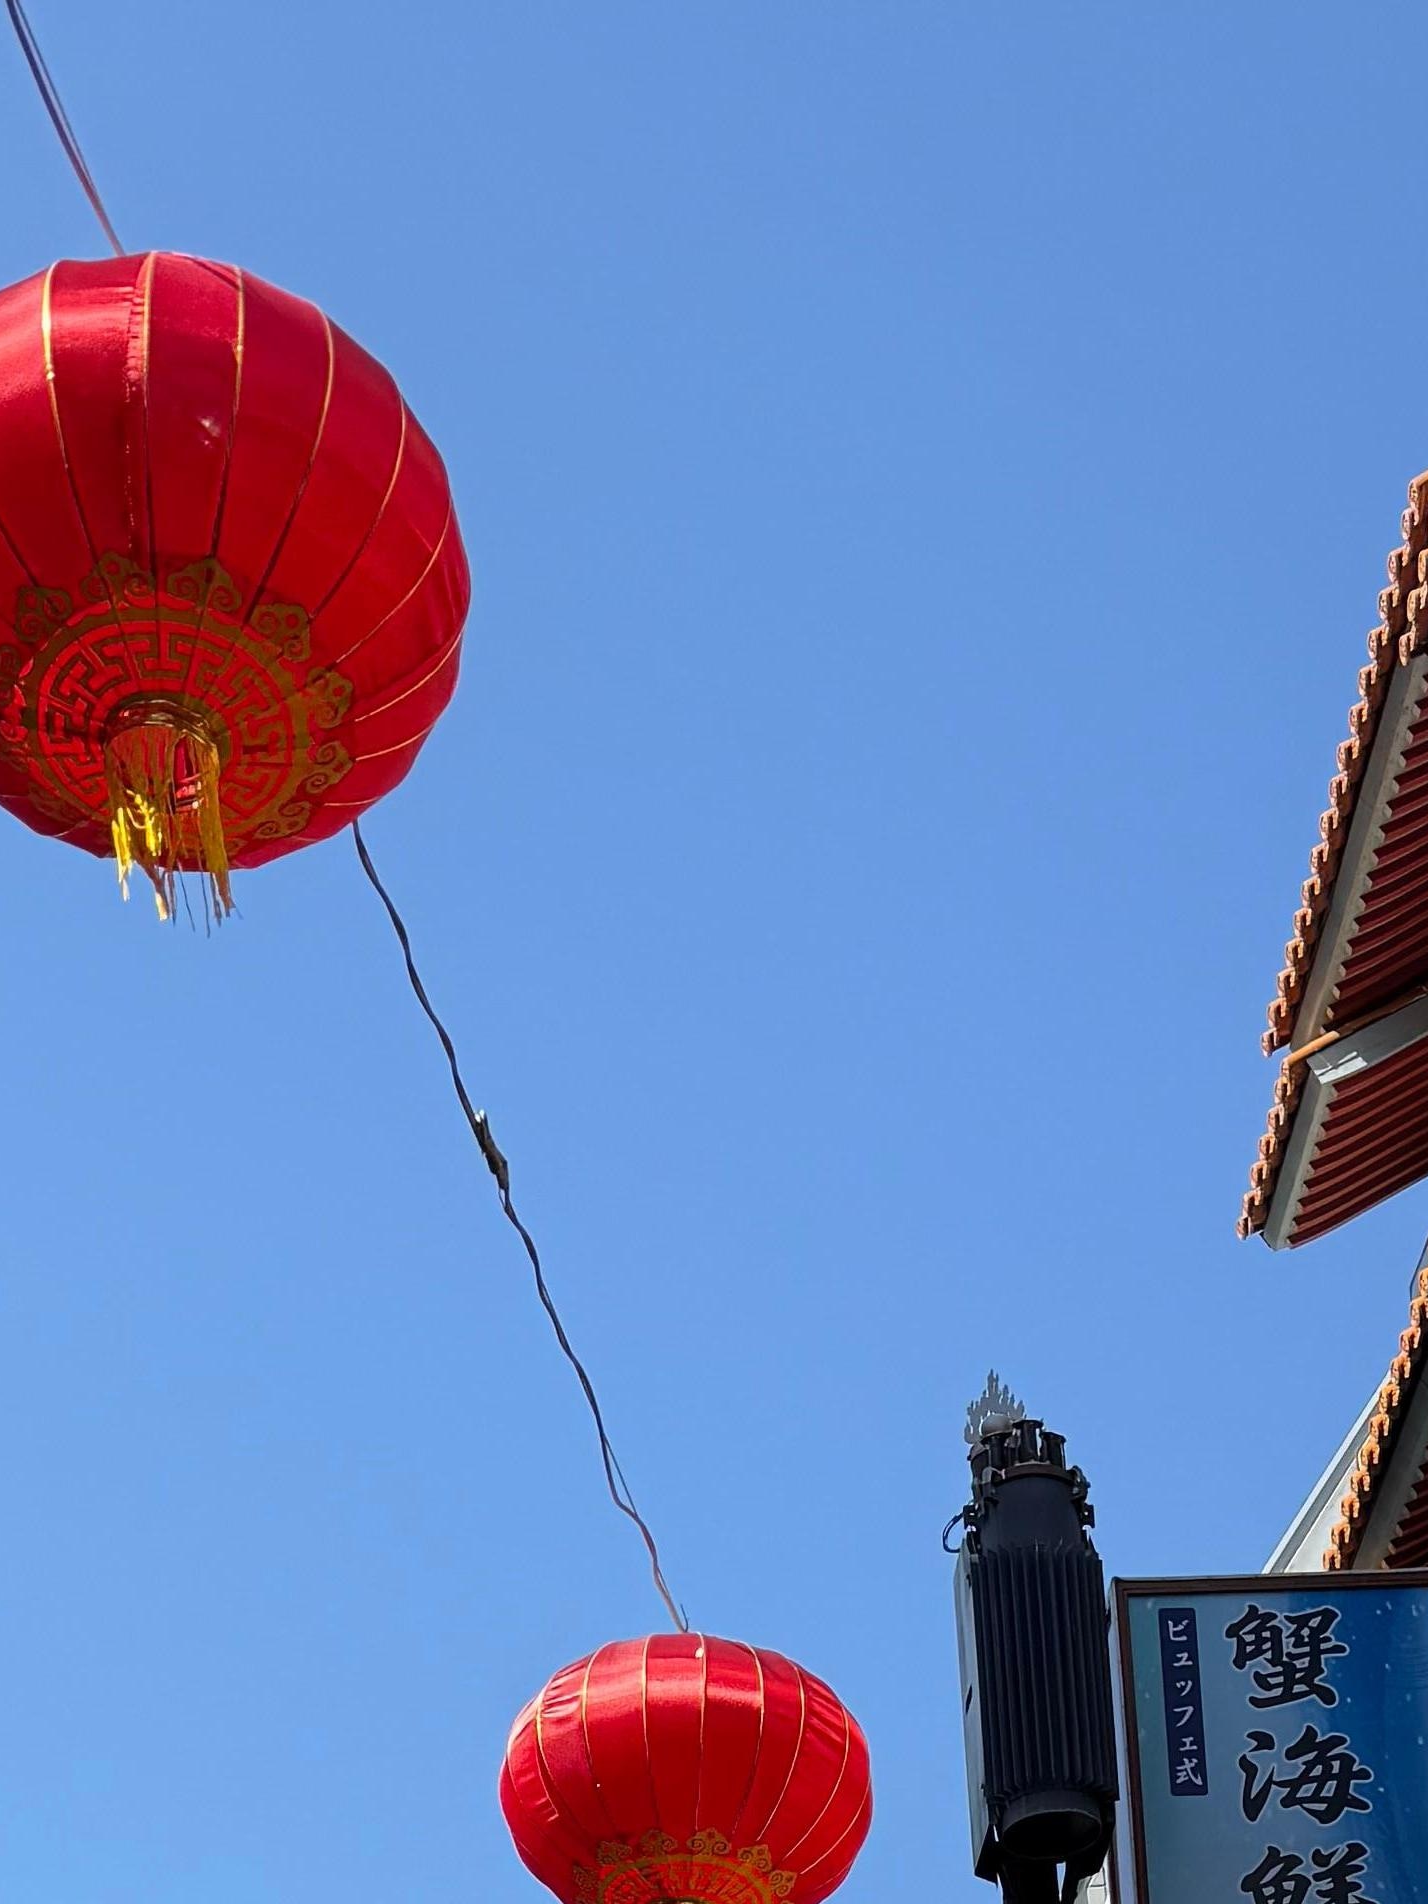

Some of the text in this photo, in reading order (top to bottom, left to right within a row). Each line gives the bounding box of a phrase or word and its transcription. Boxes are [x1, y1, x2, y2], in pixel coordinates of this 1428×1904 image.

[1165, 1616, 1204, 1788] ビュッフェ式
